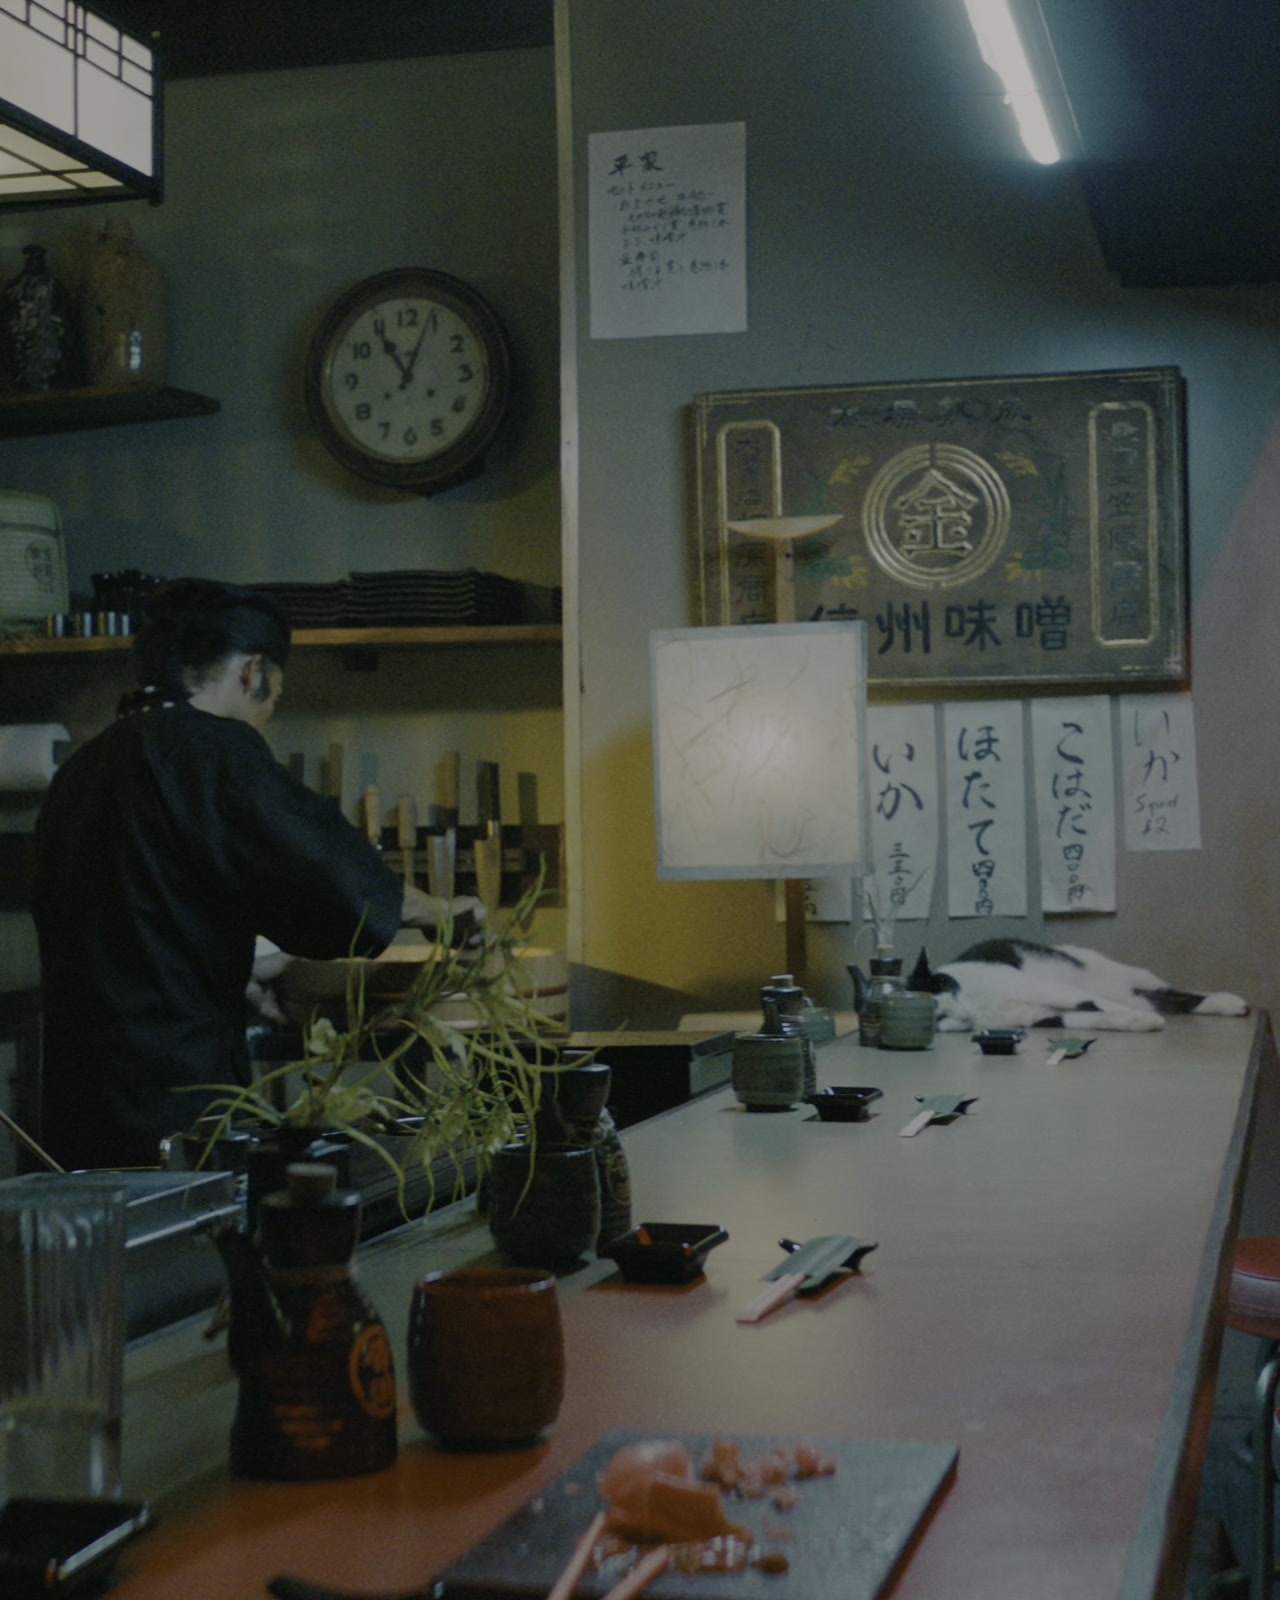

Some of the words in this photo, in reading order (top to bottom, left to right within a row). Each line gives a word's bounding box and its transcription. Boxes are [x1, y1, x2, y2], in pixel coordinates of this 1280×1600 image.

[397, 308, 418, 327] 12
[353, 342, 371, 360] 10
[450, 335, 465, 353] 2
[345, 373, 359, 390] 9
[458, 364, 473, 382] 3
[356, 404, 371, 420] 8
[451, 396, 467, 413] 4
[378, 422, 391, 440] 7
[403, 428, 418, 445] 6
[430, 420, 444, 436] 5
[893, 468, 980, 559] 金
[1134, 709, 1180, 784] いか
[872, 742, 923, 820] いか
[1134, 793, 1178, 817] Squid
